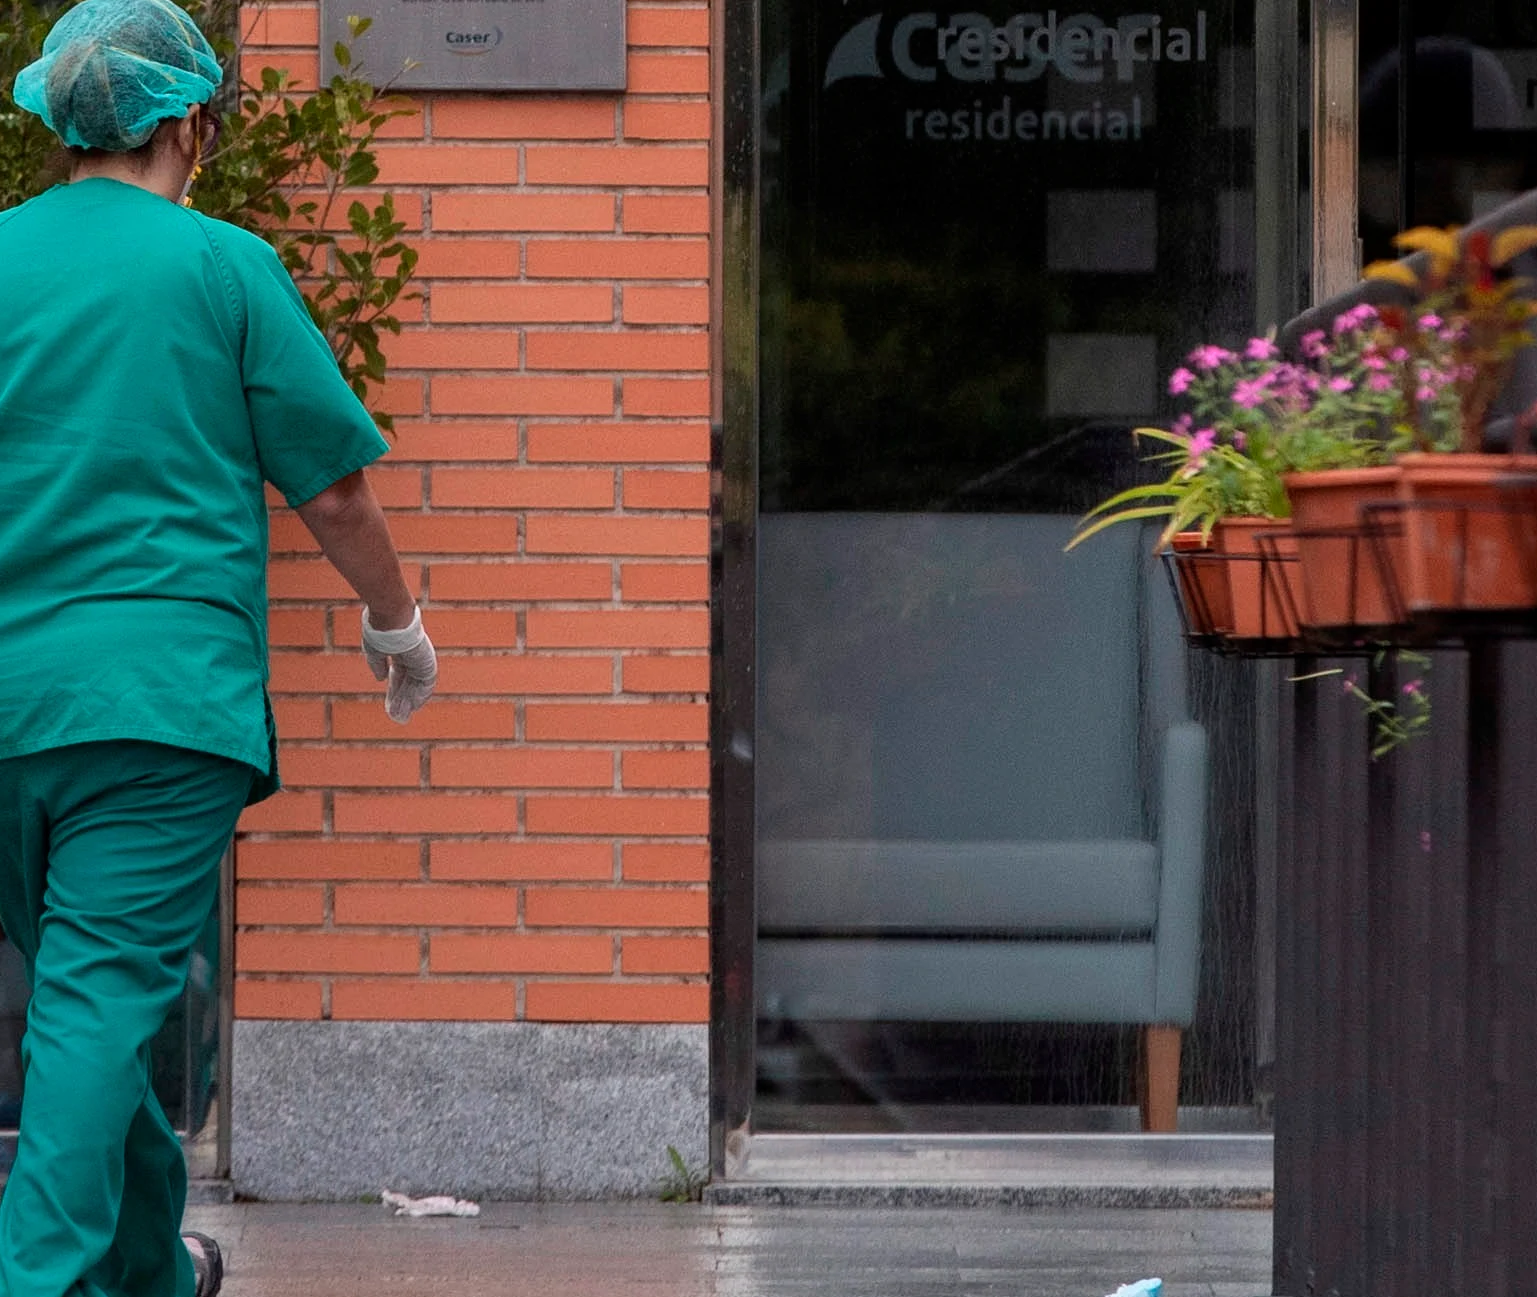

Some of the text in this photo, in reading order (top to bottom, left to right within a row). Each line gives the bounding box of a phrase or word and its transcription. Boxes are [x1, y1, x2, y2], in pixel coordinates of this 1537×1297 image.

[446, 32, 490, 44] Caser
[891, 12, 1156, 82] caser
[937, 11, 1207, 61] residencial
[905, 96, 1141, 140] residencial
